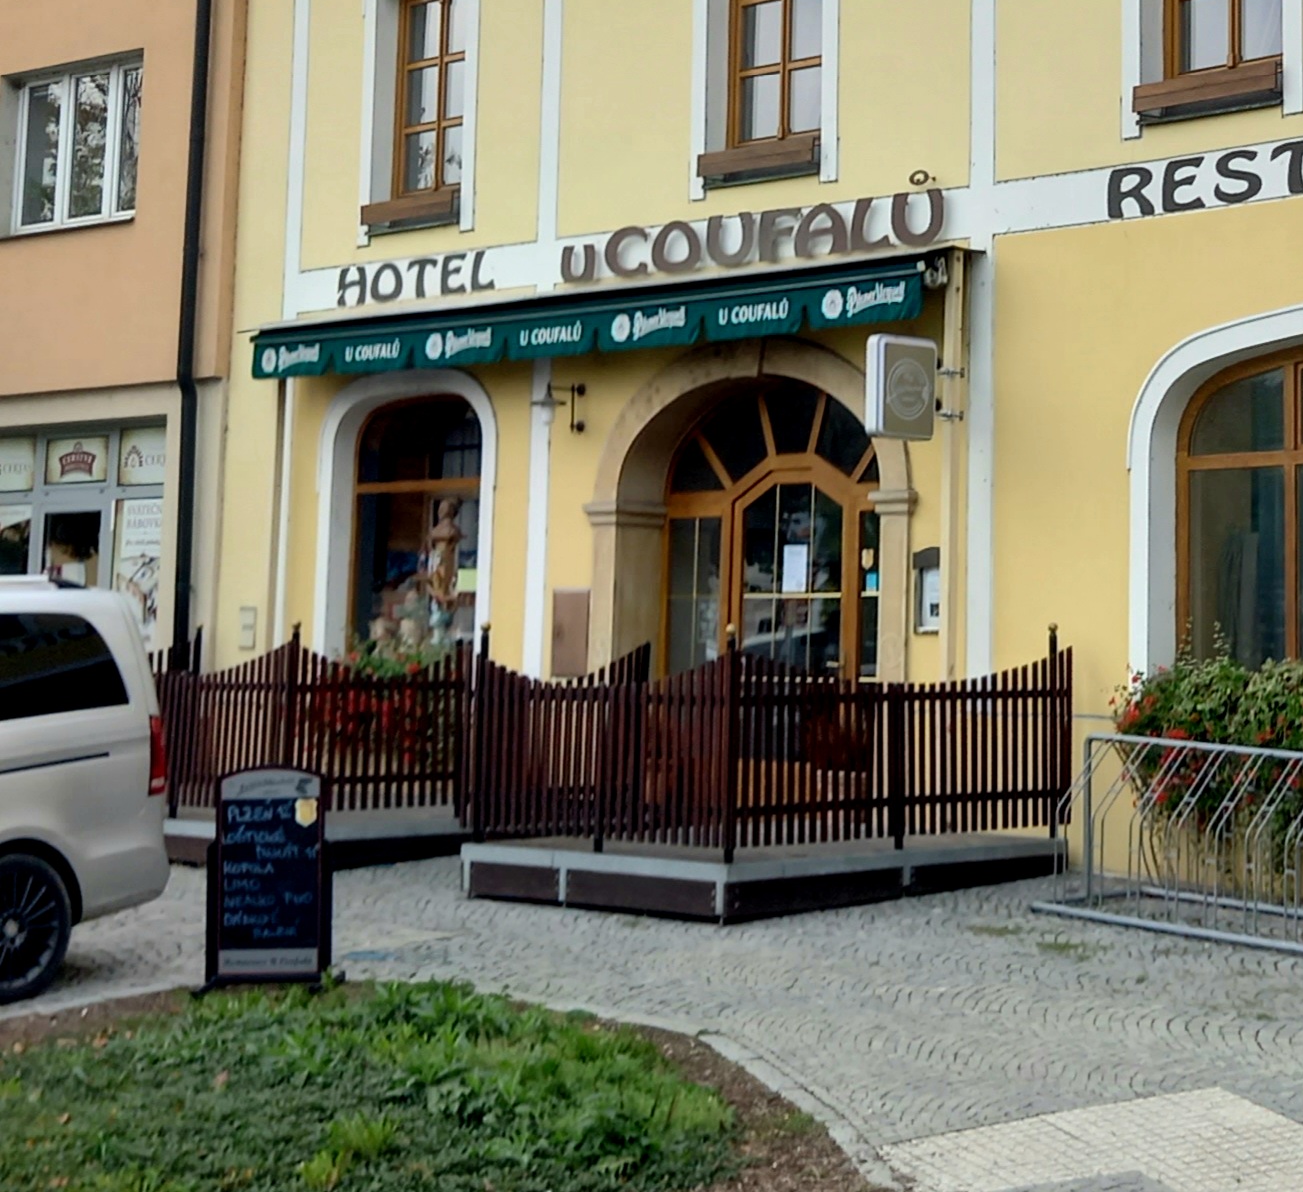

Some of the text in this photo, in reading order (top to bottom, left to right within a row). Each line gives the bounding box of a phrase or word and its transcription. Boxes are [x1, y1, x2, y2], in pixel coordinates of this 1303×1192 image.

[337, 250, 495, 307] HOTEL
[718, 297, 789, 325] U COUFALŮ
[519, 320, 583, 347] U COUFALŮ
[345, 346, 354, 362] U
